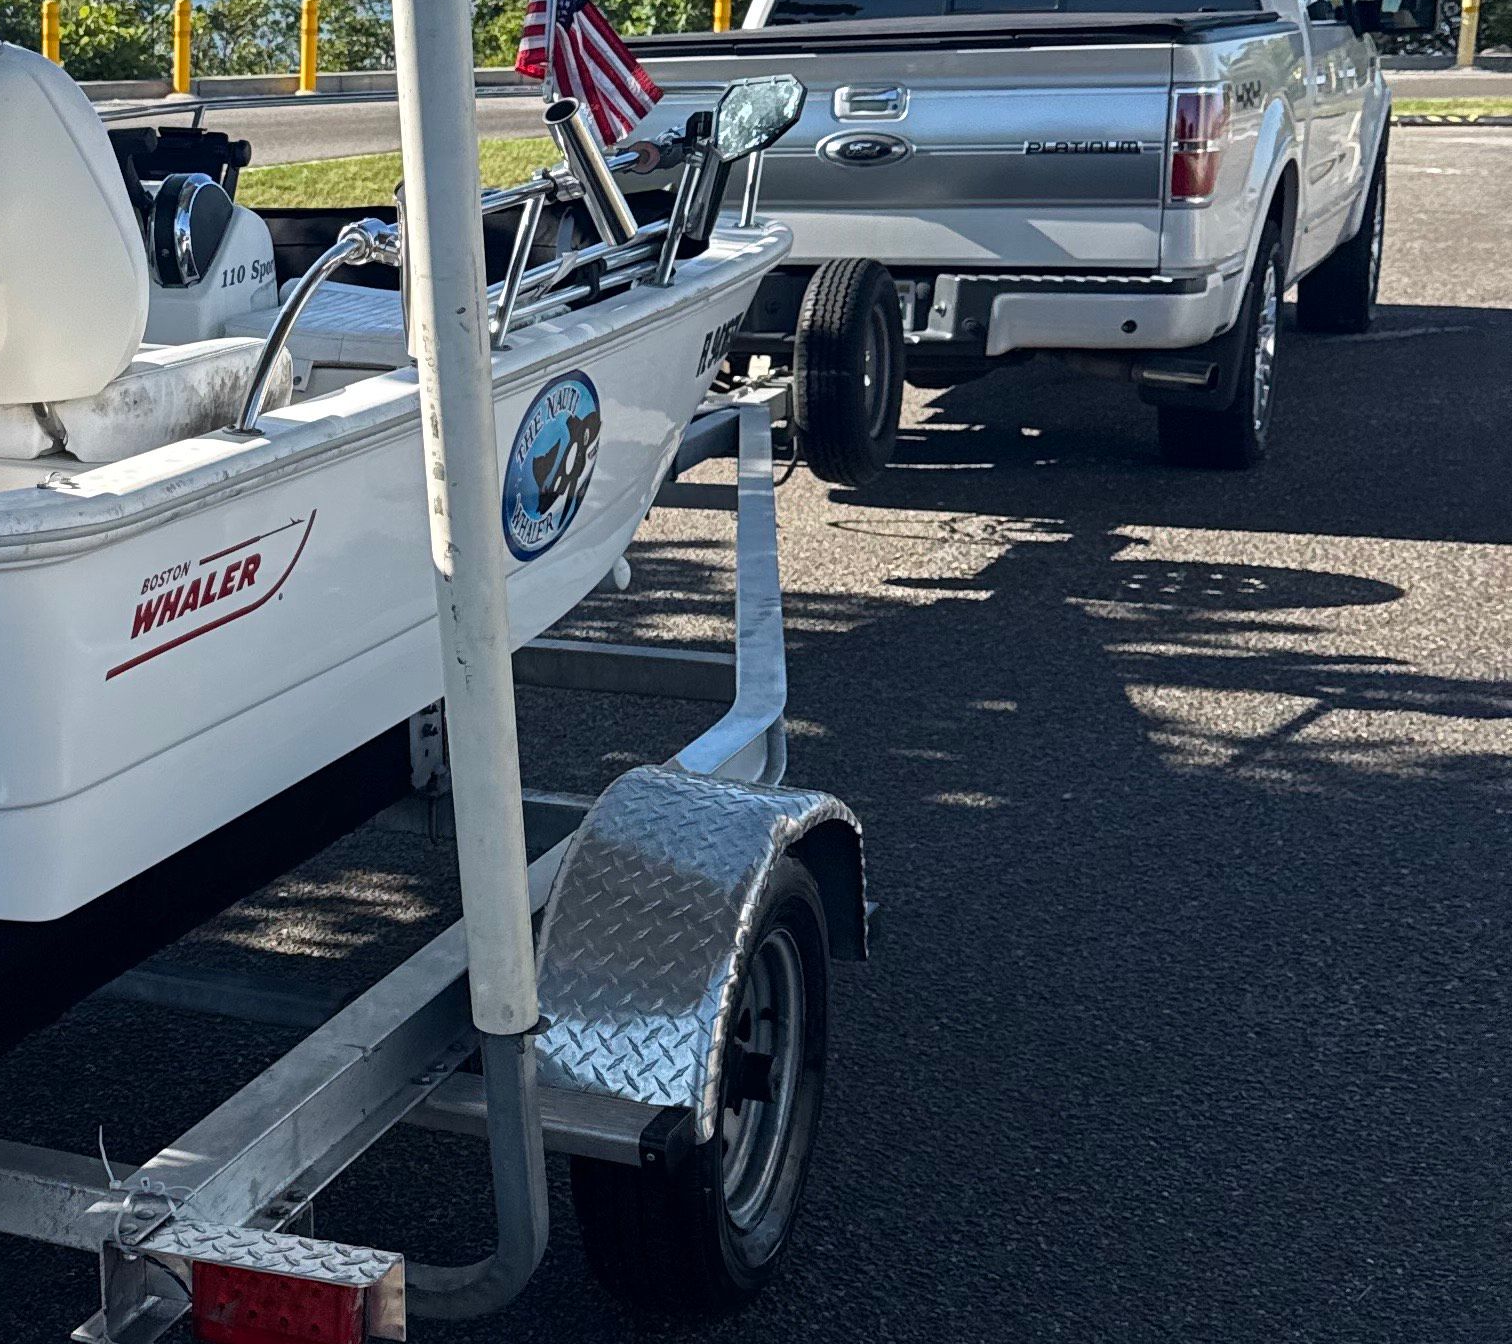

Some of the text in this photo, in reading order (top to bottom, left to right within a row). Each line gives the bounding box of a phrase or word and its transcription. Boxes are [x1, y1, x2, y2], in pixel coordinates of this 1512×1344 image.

[1026, 141, 1141, 156] PLATINUM
[221, 259, 274, 288] 110 Spor
[517, 386, 580, 464] THE NAUTI
[511, 498, 554, 544] WHALER
[130, 553, 262, 640] WHALER
[140, 559, 192, 596] BOSTON
